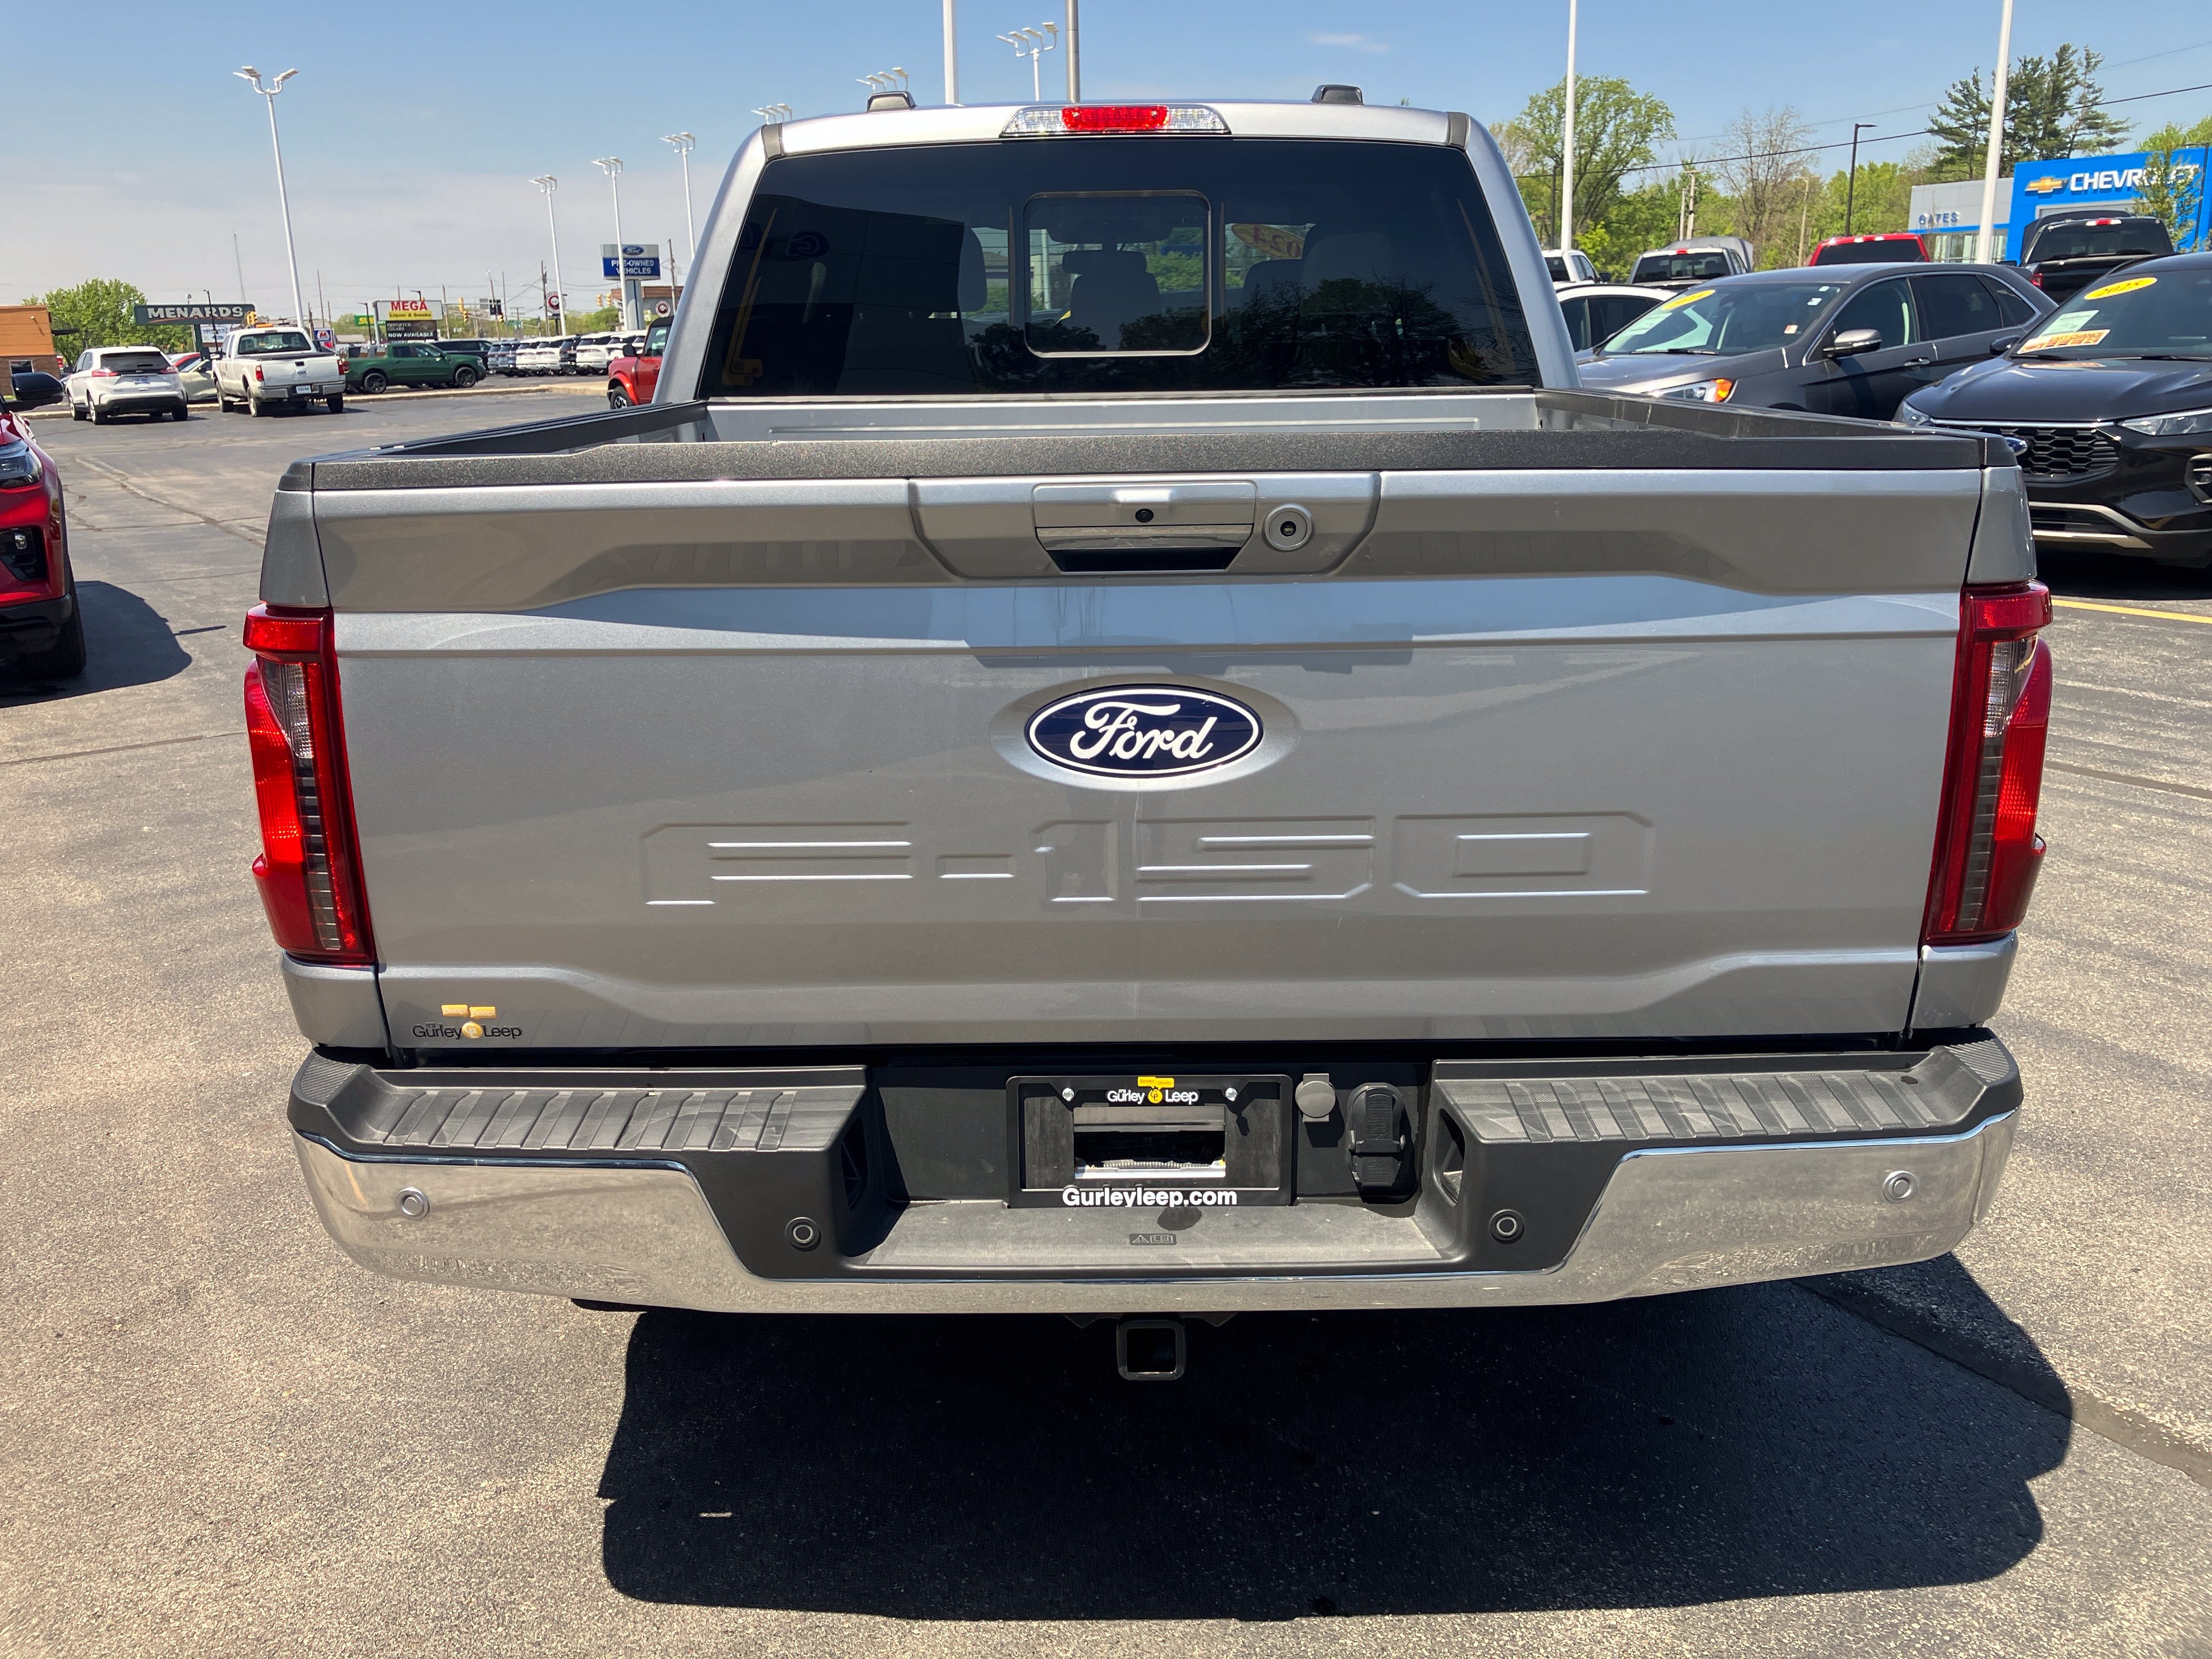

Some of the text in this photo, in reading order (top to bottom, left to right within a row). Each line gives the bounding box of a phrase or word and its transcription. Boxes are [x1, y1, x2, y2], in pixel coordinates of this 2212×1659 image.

[2070, 164, 2199, 191] CHEVROET
[1918, 212, 1958, 224] GATES
[147, 306, 243, 319] MENARDS
[391, 301, 427, 311] MEGA
[1069, 701, 1218, 759] Ford
[640, 812, 1655, 906] F-150
[413, 1024, 522, 1040] Gurley Leep
[1107, 1090, 1199, 1105] Gurley Leep
[1062, 1187, 1237, 1207] Gurleyleep.com
